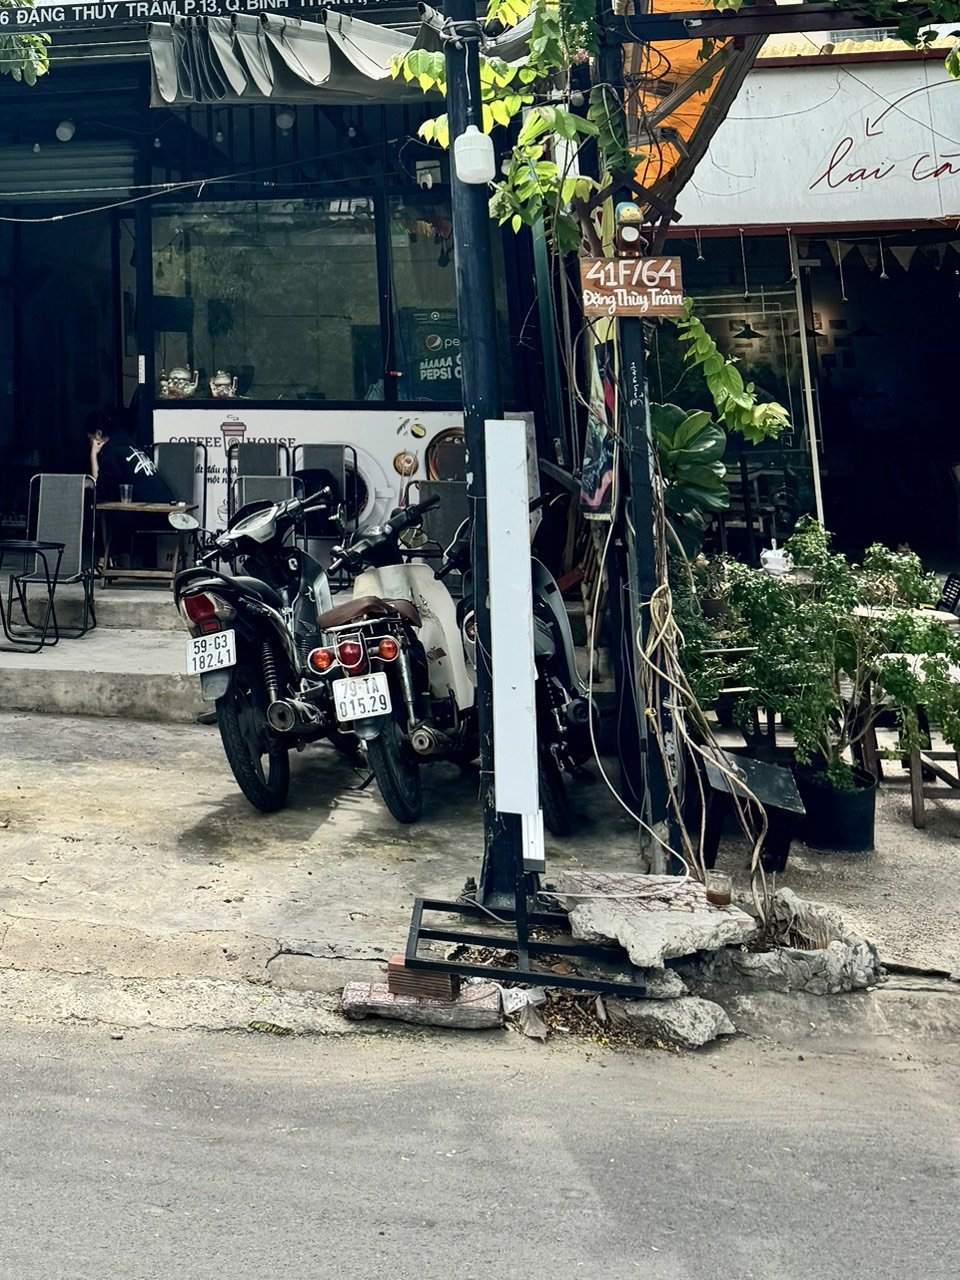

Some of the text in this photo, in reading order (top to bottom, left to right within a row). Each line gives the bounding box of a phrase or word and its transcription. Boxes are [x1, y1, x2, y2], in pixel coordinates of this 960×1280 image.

[810, 136, 896, 190] lai
[585, 259, 676, 287] 41F/64
[582, 288, 684, 314] Đặng Thùy Trâm
[444, 338, 460, 349] pe
[420, 367, 452, 380] PEPSI
[193, 634, 228, 655] 59-G3
[192, 648, 232, 671] 182.41
[342, 677, 379, 699] 79-TA
[339, 696, 388, 718] 015.29
